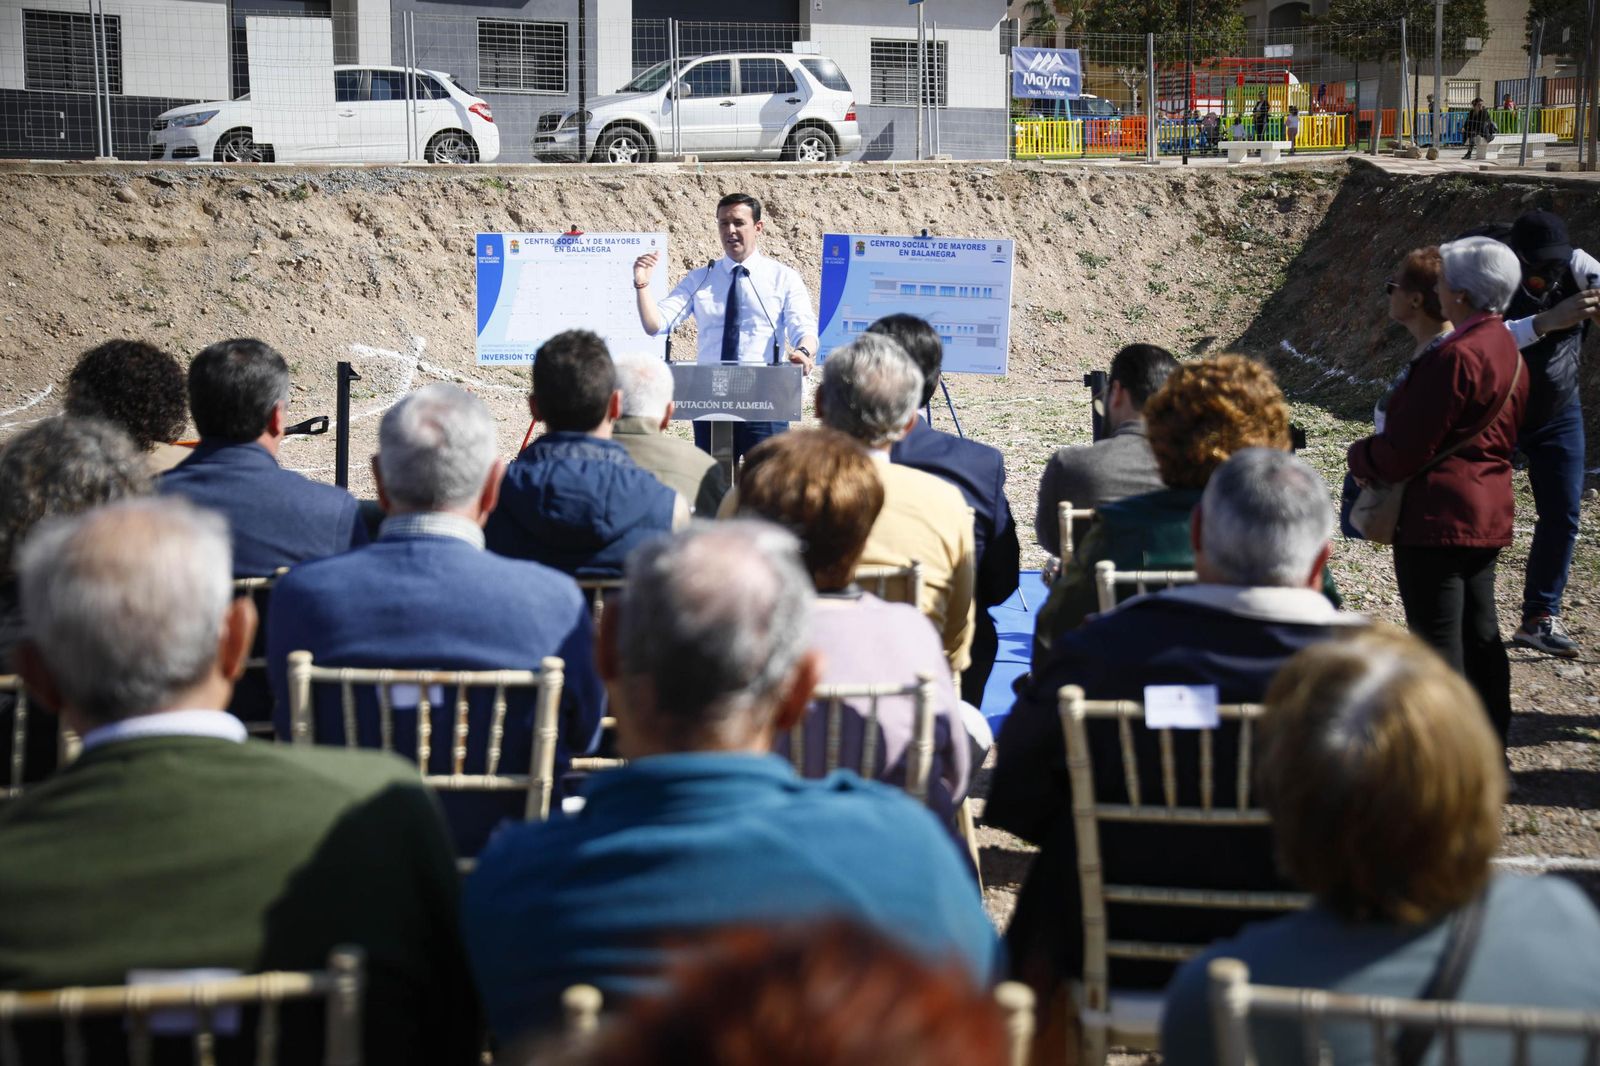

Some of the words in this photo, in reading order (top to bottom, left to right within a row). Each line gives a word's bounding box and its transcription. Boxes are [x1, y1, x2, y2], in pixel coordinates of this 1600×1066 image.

[1023, 72, 1070, 89] Mayfra
[938, 242, 948, 250] DE
[950, 243, 987, 251] MAYORES
[911, 249, 957, 258] BALANEGRA
[481, 353, 523, 361] INVERSIÓN
[672, 399, 720, 409] IPUTACIÓN
[722, 401, 733, 409] DE
[735, 400, 775, 410] ALMERÍA
